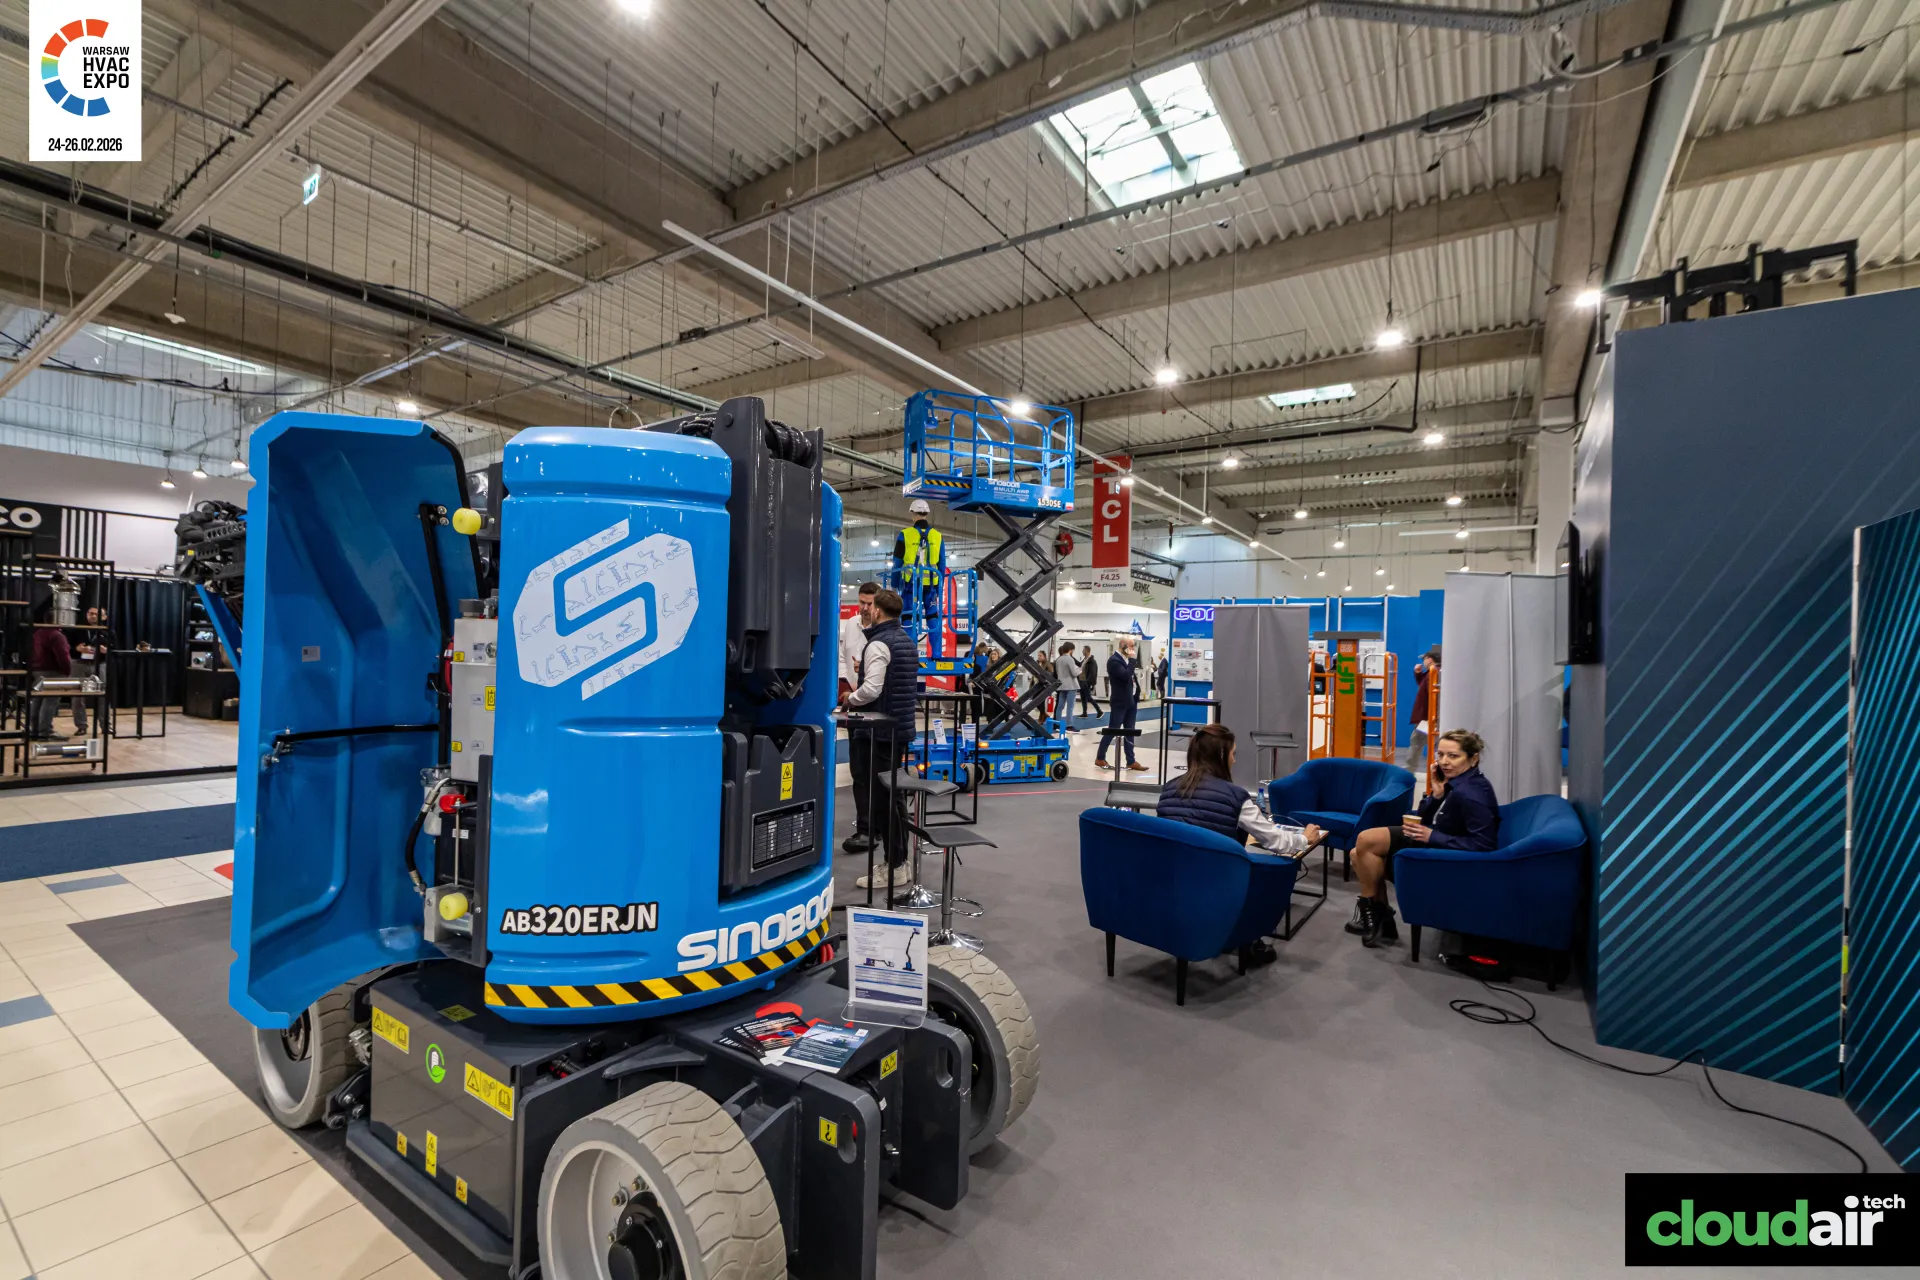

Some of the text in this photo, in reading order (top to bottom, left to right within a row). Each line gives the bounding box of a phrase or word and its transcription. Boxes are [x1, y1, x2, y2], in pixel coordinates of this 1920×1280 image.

[1100, 573, 1121, 581] F4.25
[1337, 652, 1356, 695] LIFT
[501, 902, 659, 935] AB320ERJN
[676, 876, 835, 973] SINOBOO
